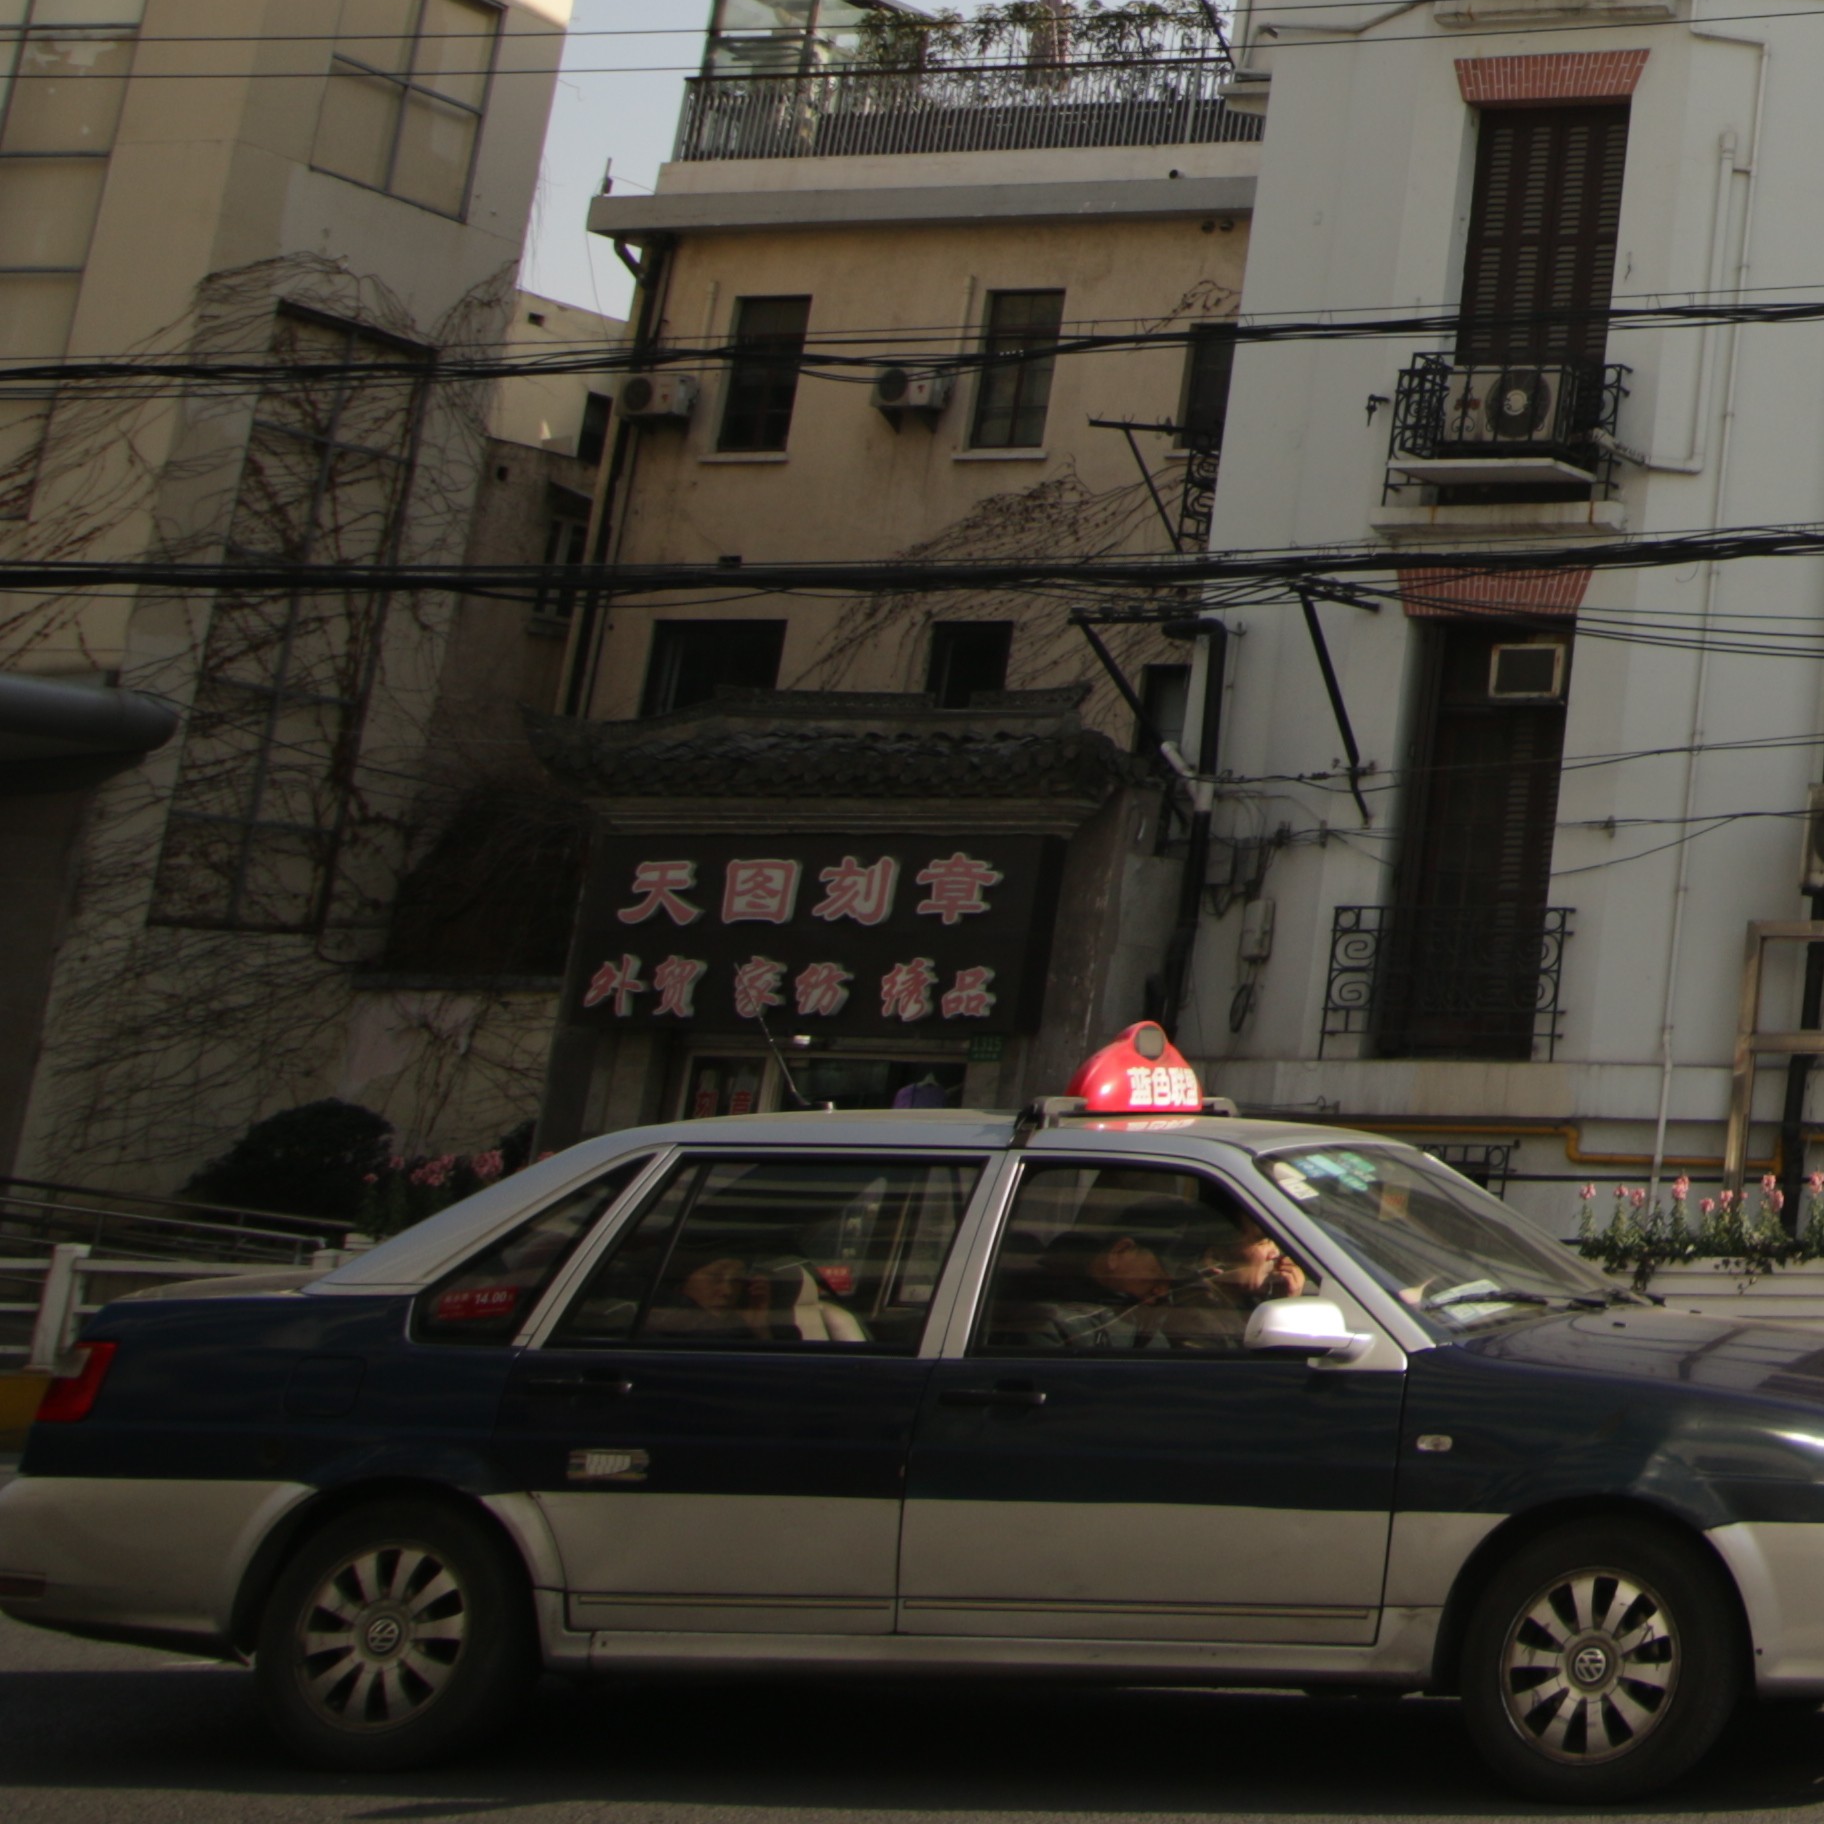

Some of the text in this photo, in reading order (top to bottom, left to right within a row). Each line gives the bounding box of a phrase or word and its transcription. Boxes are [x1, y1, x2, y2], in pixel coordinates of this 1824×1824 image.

[617, 851, 1001, 926] 天图刻章
[584, 953, 997, 1022] 外贸 家纺 绣品
